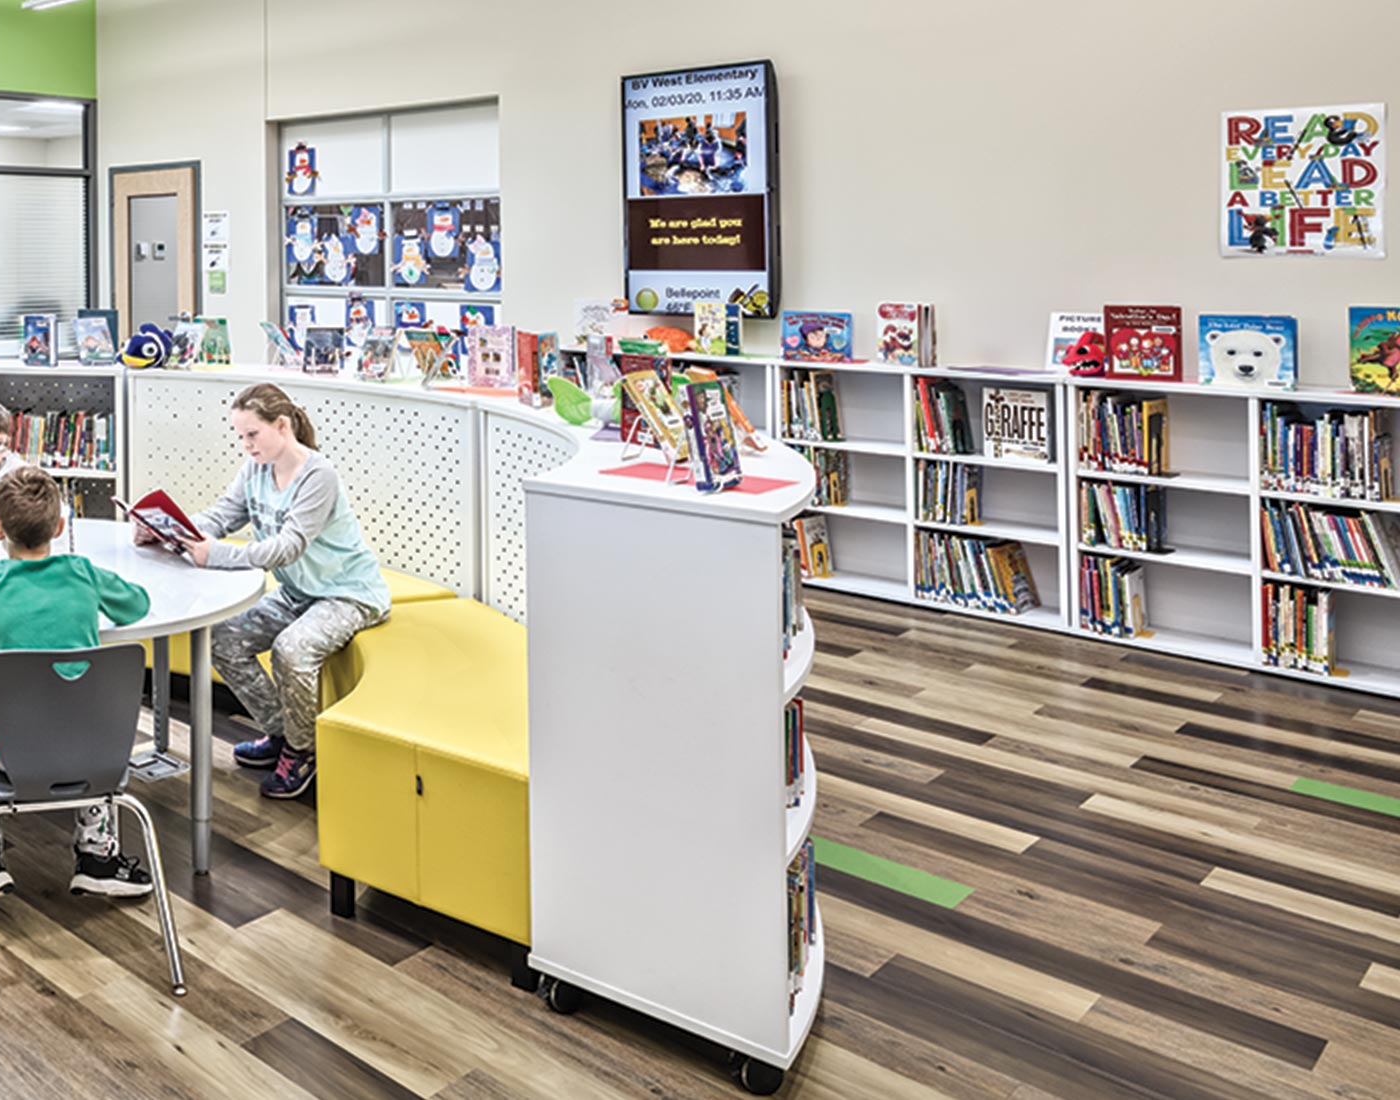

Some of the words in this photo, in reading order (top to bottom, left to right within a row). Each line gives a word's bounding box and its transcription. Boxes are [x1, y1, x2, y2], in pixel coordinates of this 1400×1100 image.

[631, 79, 649, 90] BV
[651, 76, 682, 87] West
[685, 68, 758, 84] Elementary
[710, 88, 741, 101] 11:35
[1226, 111, 1379, 146] READ
[1228, 158, 1378, 190] LEAD
[1226, 191, 1249, 207] A
[1259, 189, 1375, 207] BETTER
[648, 218, 666, 228] We
[668, 220, 688, 228] are
[690, 217, 717, 229] glad
[718, 218, 742, 228] you
[1227, 207, 1376, 247] LIFE
[651, 237, 670, 245] are
[672, 234, 700, 245] here
[702, 234, 740, 246] today!
[665, 287, 720, 300] Bellepoint
[984, 402, 1046, 441] GIRAFFE
